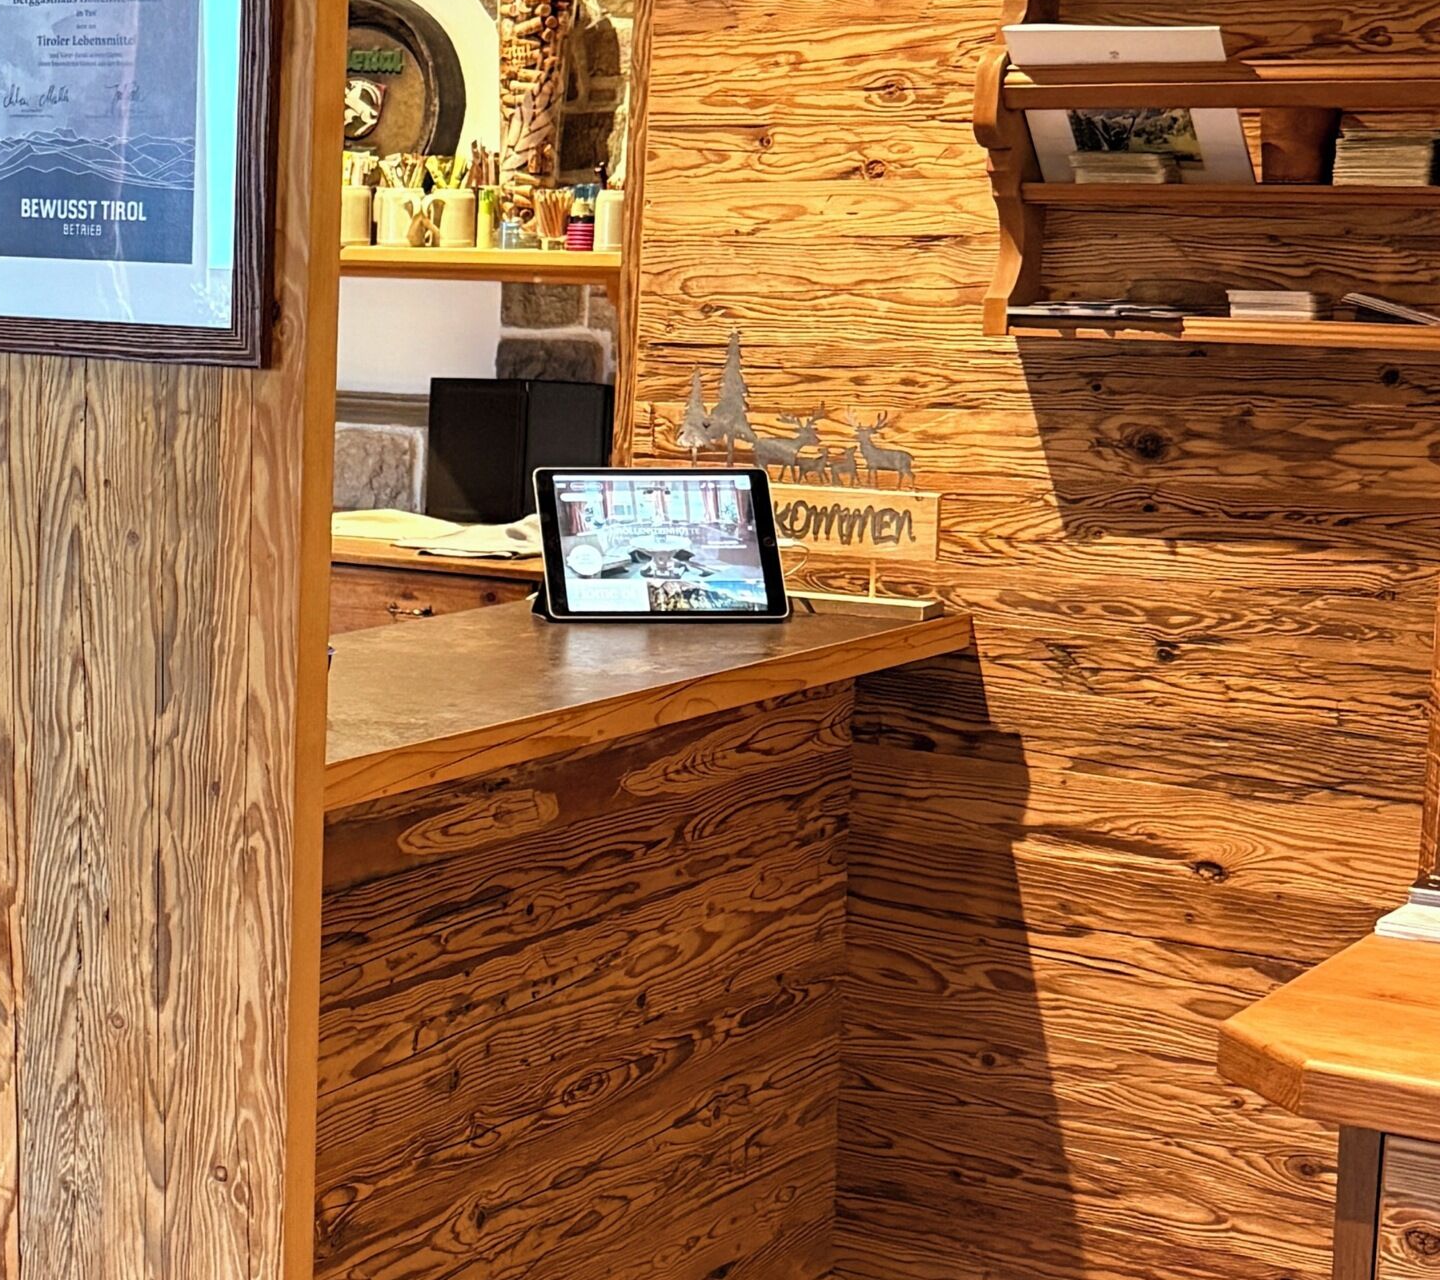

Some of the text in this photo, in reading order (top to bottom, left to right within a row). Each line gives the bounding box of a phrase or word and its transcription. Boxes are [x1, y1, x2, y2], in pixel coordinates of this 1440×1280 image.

[36, 34, 70, 47] Tiroler
[21, 198, 147, 221] BEWUSST TIROL
[63, 224, 102, 236] BETRIEB
